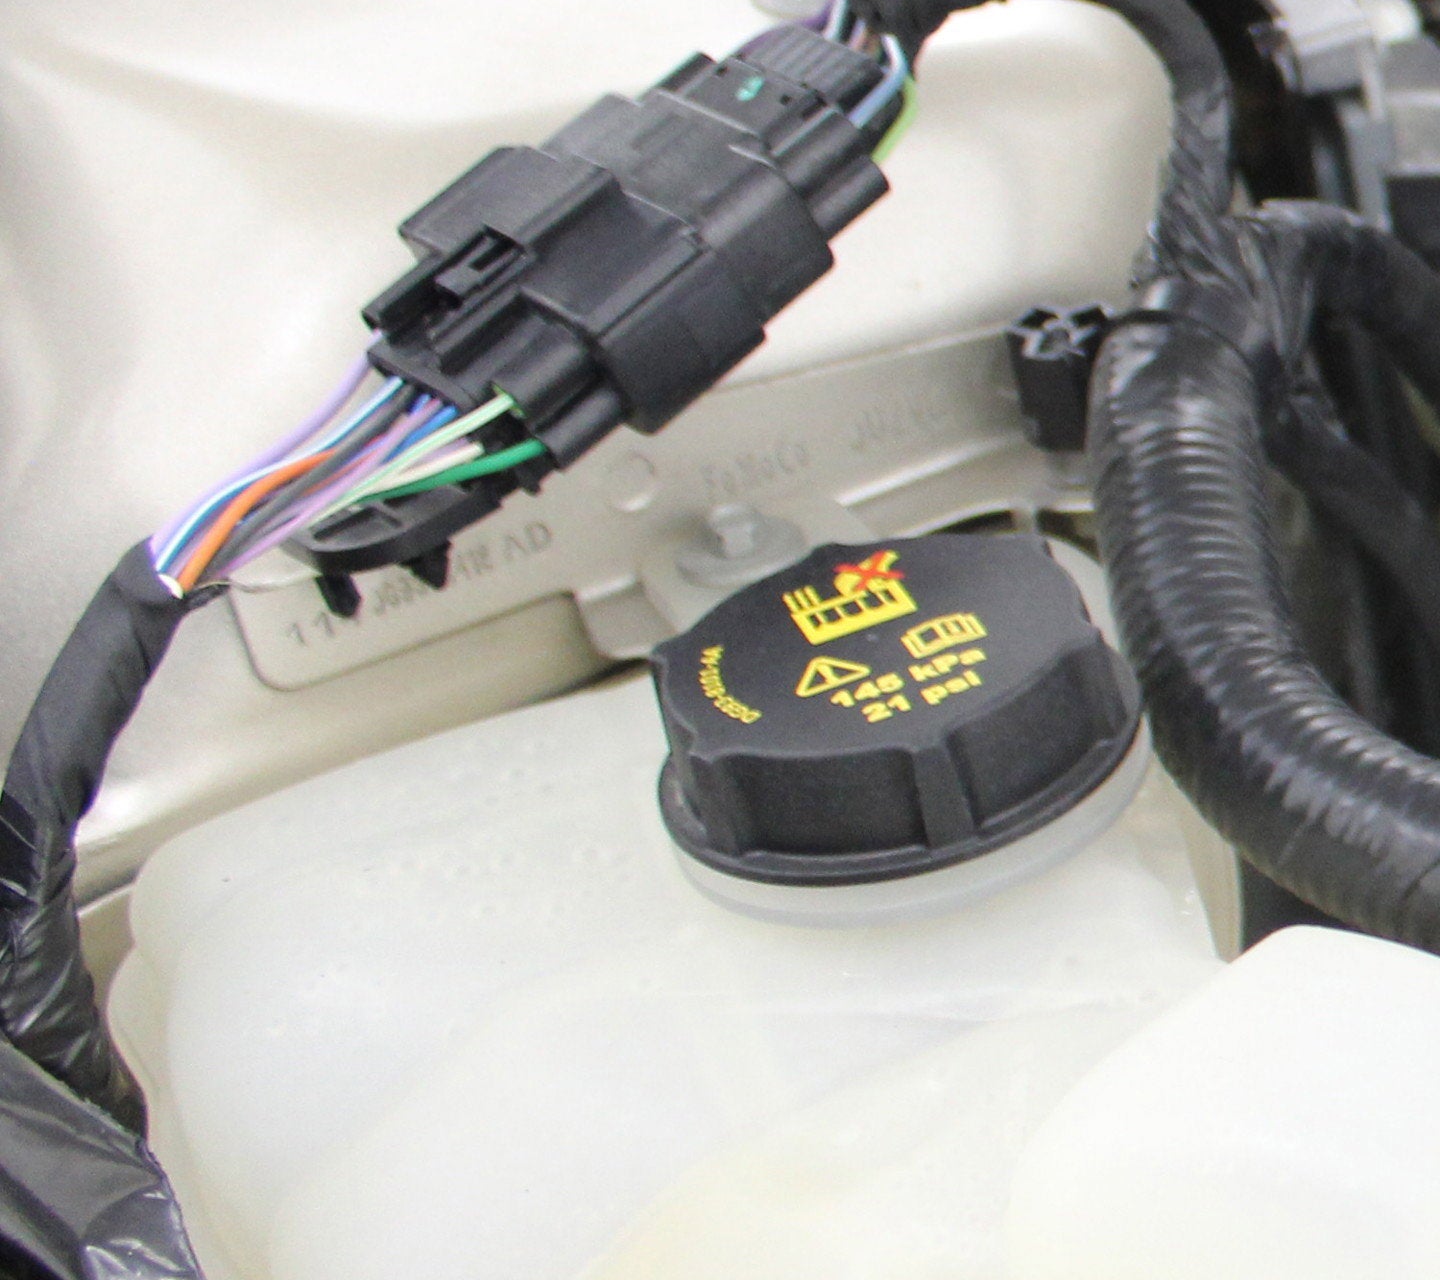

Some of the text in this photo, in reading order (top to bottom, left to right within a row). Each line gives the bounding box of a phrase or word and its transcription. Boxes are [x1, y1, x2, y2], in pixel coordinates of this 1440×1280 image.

[829, 647, 988, 709] 145 kPa
[860, 668, 983, 724] 21 psi
